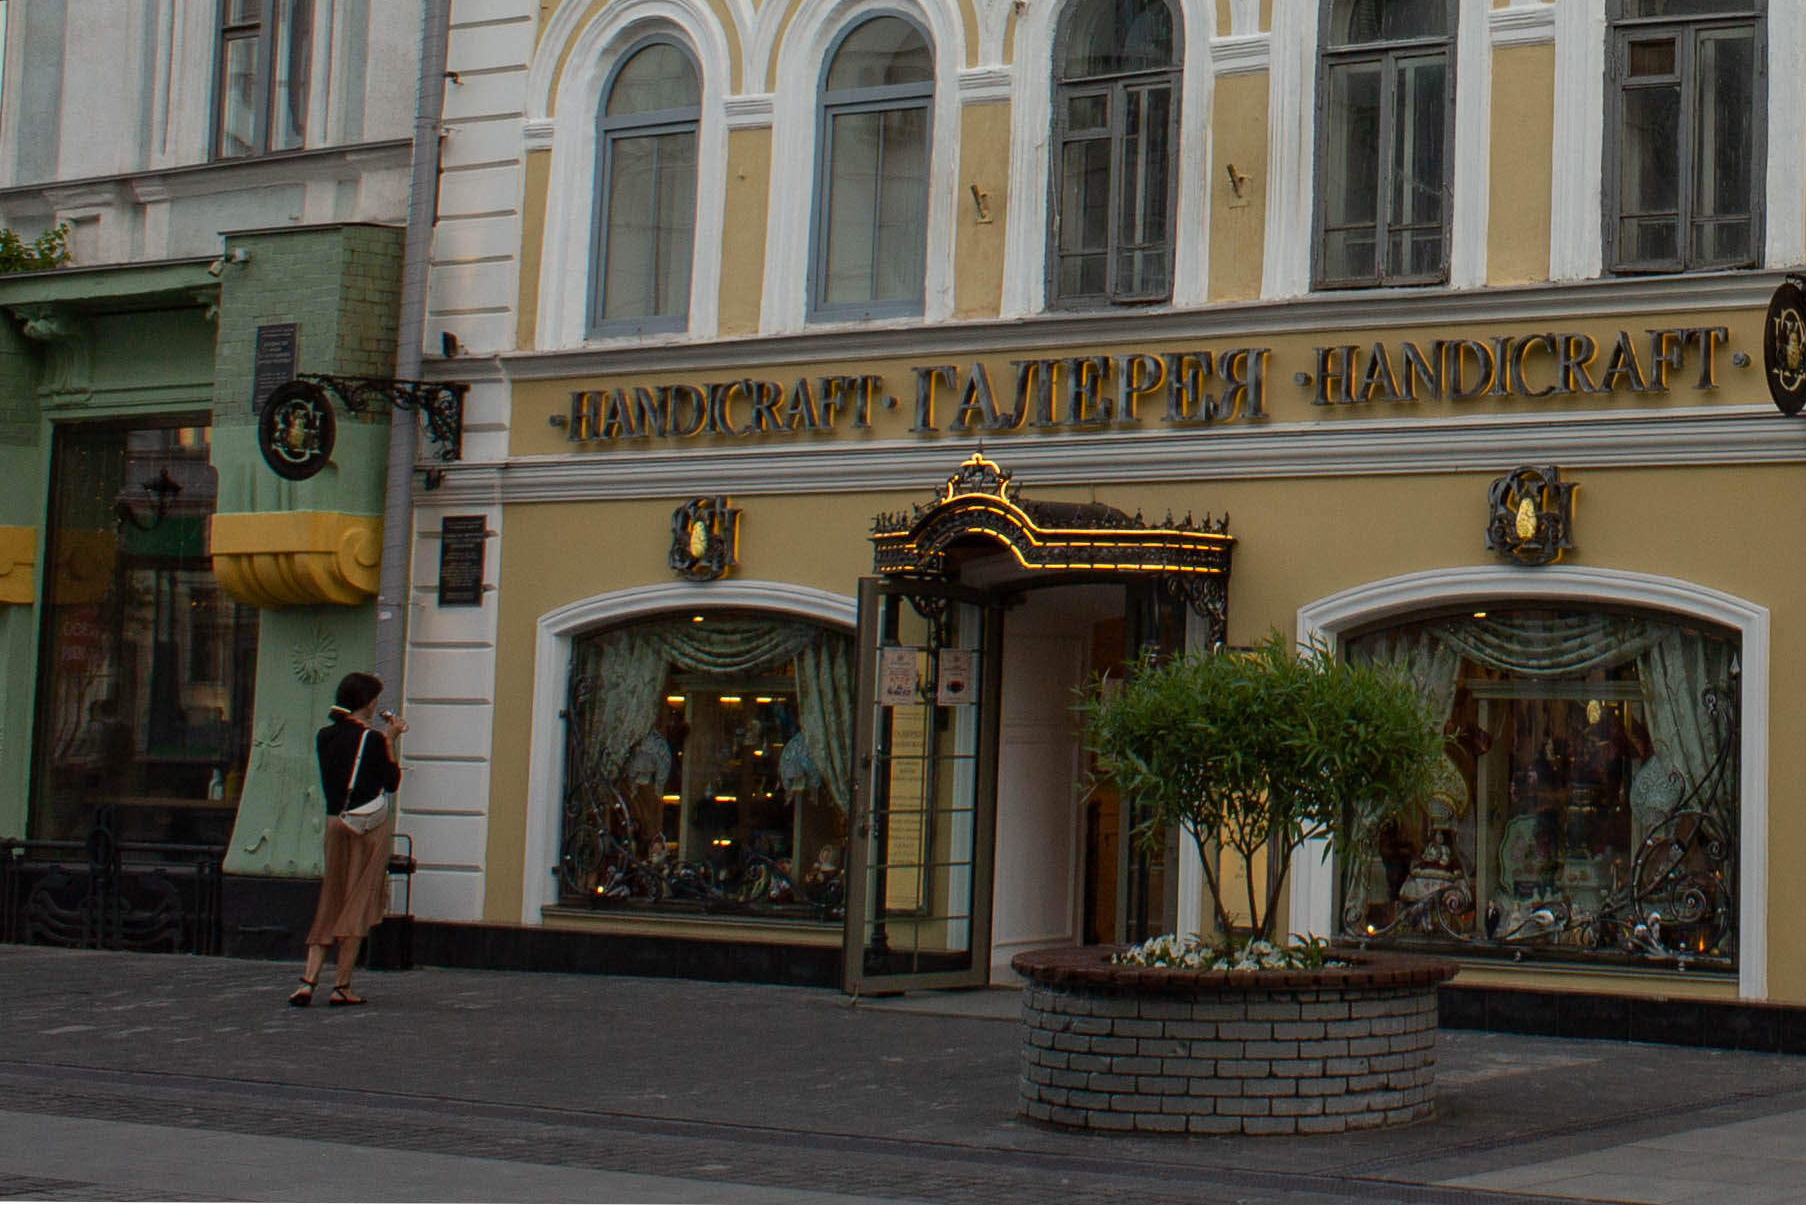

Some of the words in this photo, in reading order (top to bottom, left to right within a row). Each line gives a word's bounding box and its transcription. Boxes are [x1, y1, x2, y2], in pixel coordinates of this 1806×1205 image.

[567, 374, 882, 442] HANDICRAFT
[909, 347, 1270, 433] ГАЛЕРЕЯ
[1312, 326, 1729, 405] HANDICRAFT
